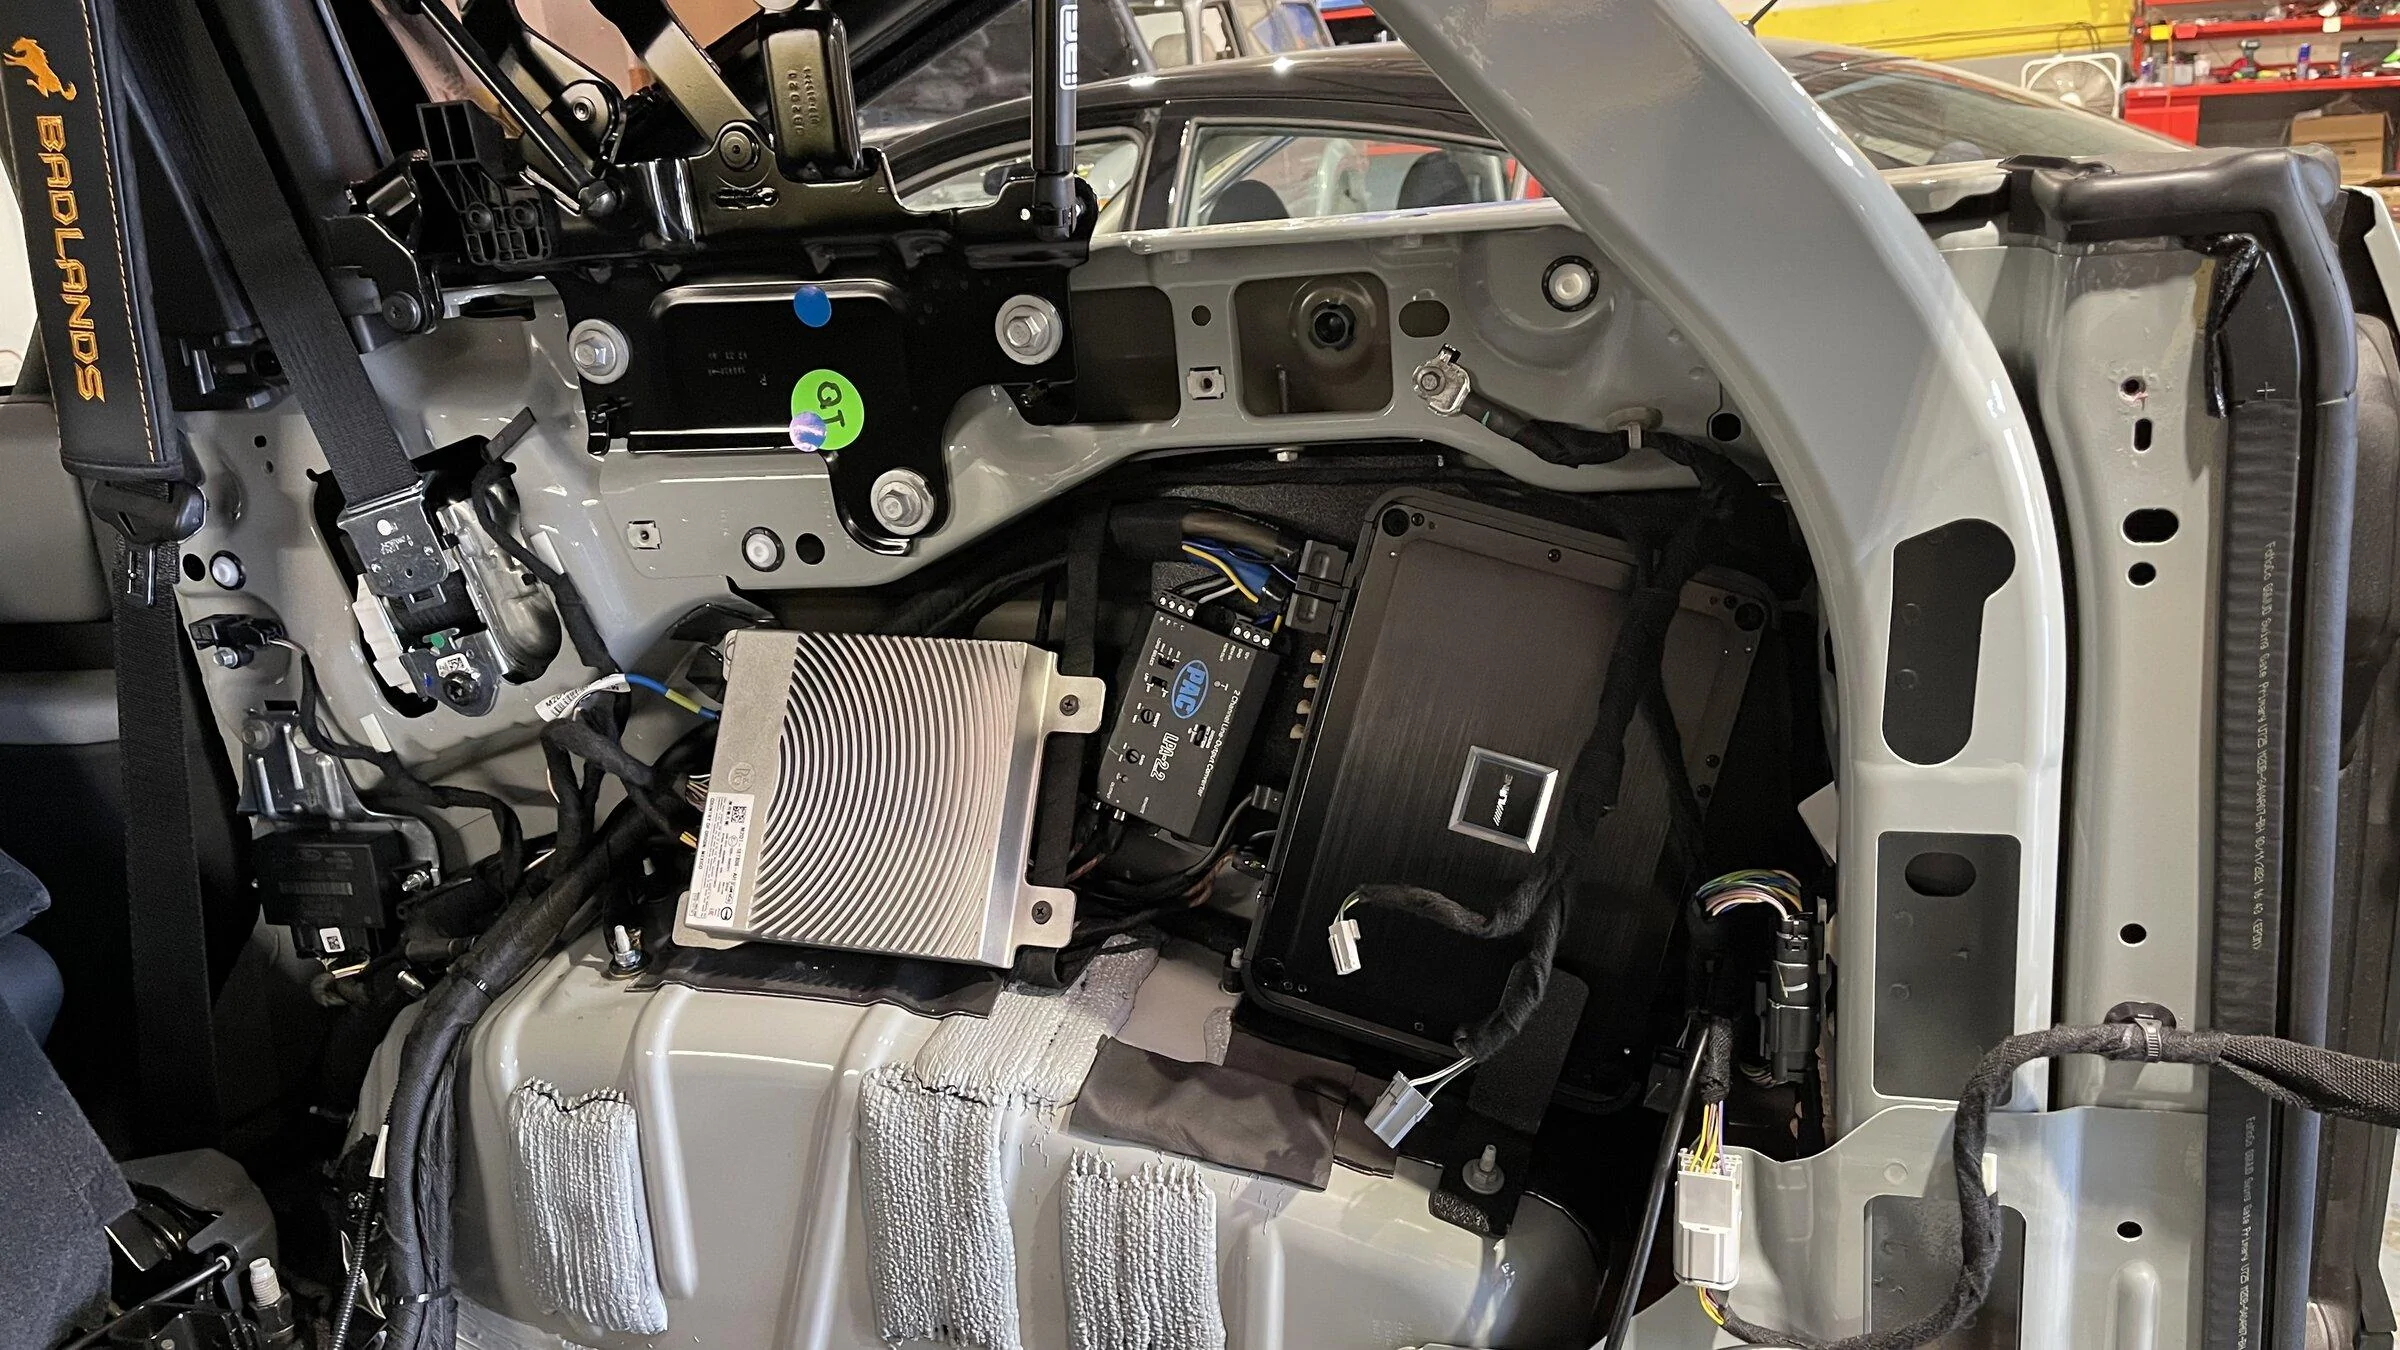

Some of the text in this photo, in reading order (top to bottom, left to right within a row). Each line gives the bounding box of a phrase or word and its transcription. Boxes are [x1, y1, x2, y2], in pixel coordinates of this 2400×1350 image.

[36, 115, 105, 402] BADLANDS
[1175, 666, 1206, 714] PAC
[1223, 694, 1238, 724] Channel
[2258, 681, 2269, 723] Primary
[1151, 733, 1178, 781] LPA-2.2
[1207, 721, 1228, 764] Line-Output
[1196, 762, 1213, 798] Converter
[706, 797, 714, 821] COUNTRY
